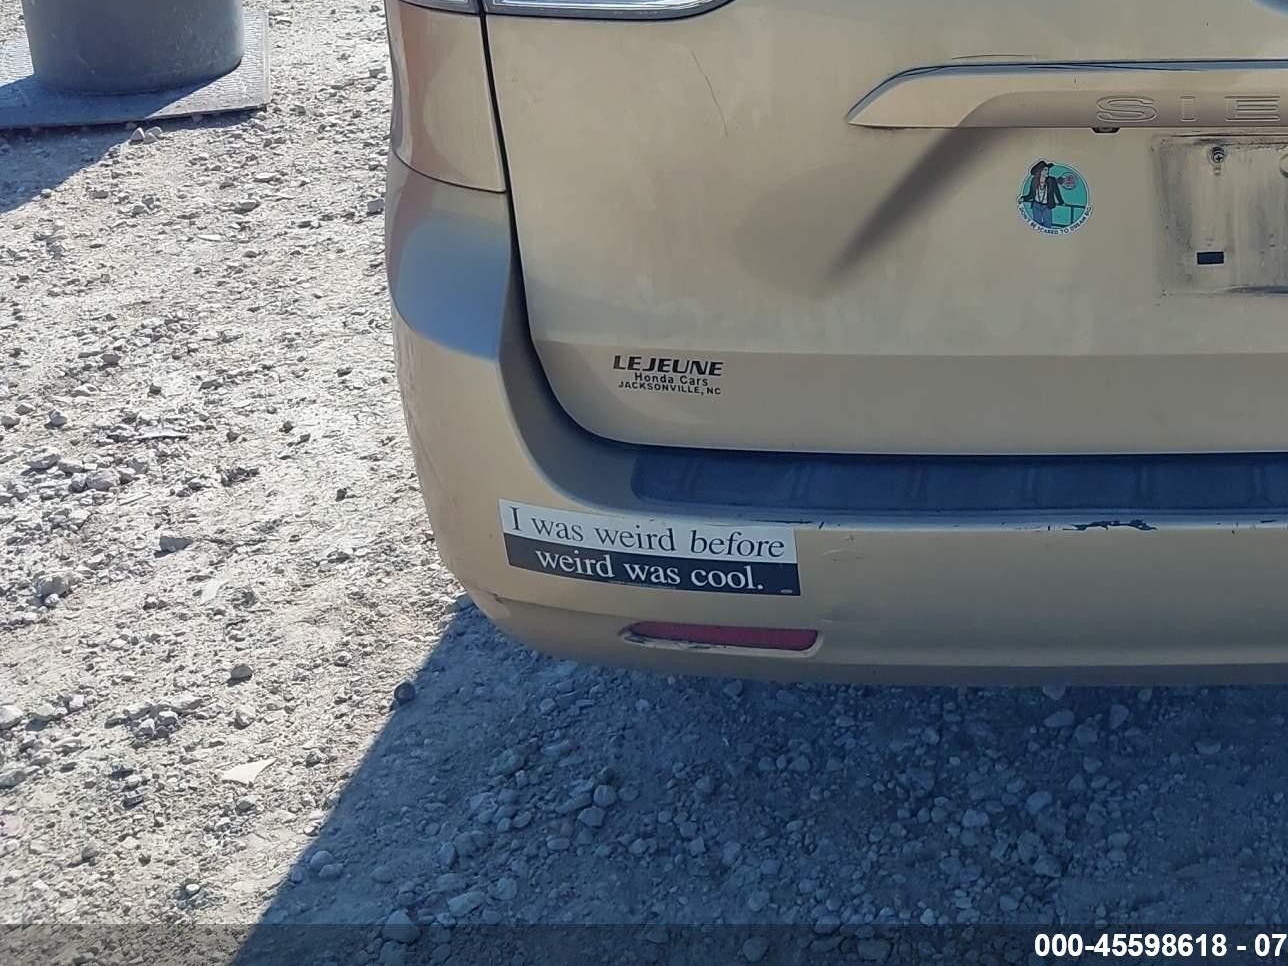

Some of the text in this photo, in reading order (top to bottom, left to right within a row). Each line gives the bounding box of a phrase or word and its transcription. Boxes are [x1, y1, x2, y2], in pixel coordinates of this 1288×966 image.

[618, 381, 721, 396] JACKSONVILLE, NC
[635, 372, 709, 387] Honda Cars
[511, 506, 785, 557] I was weird before
[536, 549, 764, 590] weird was cool.
